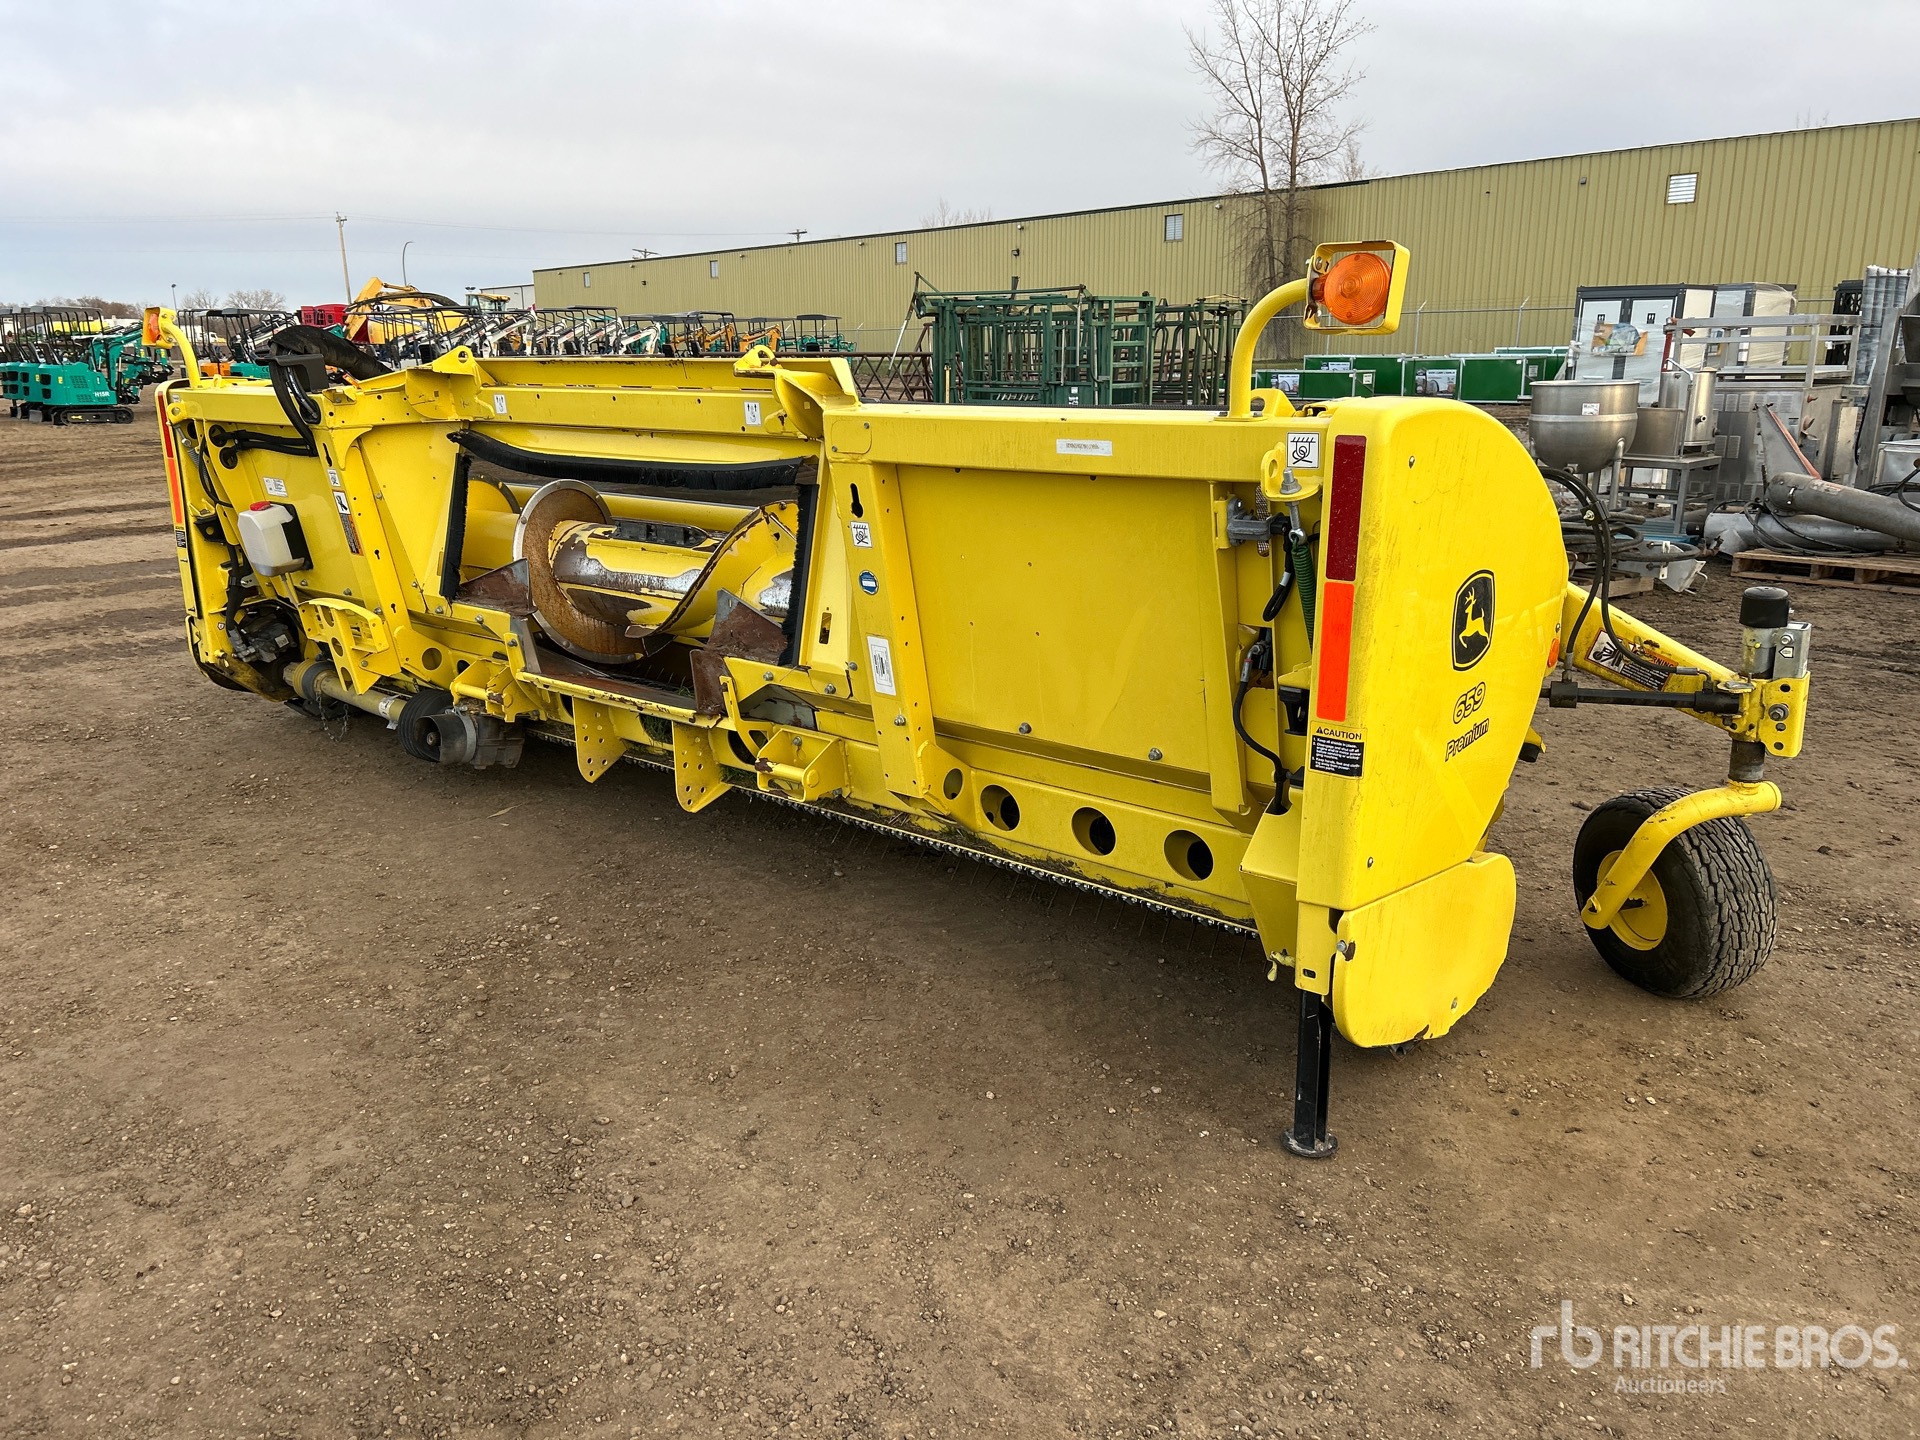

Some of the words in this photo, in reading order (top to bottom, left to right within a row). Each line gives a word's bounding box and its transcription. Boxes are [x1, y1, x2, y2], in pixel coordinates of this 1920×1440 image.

[1453, 681, 1487, 725] 659
[1323, 728, 1362, 740] CAUTION
[1445, 718, 1490, 762] Premium
